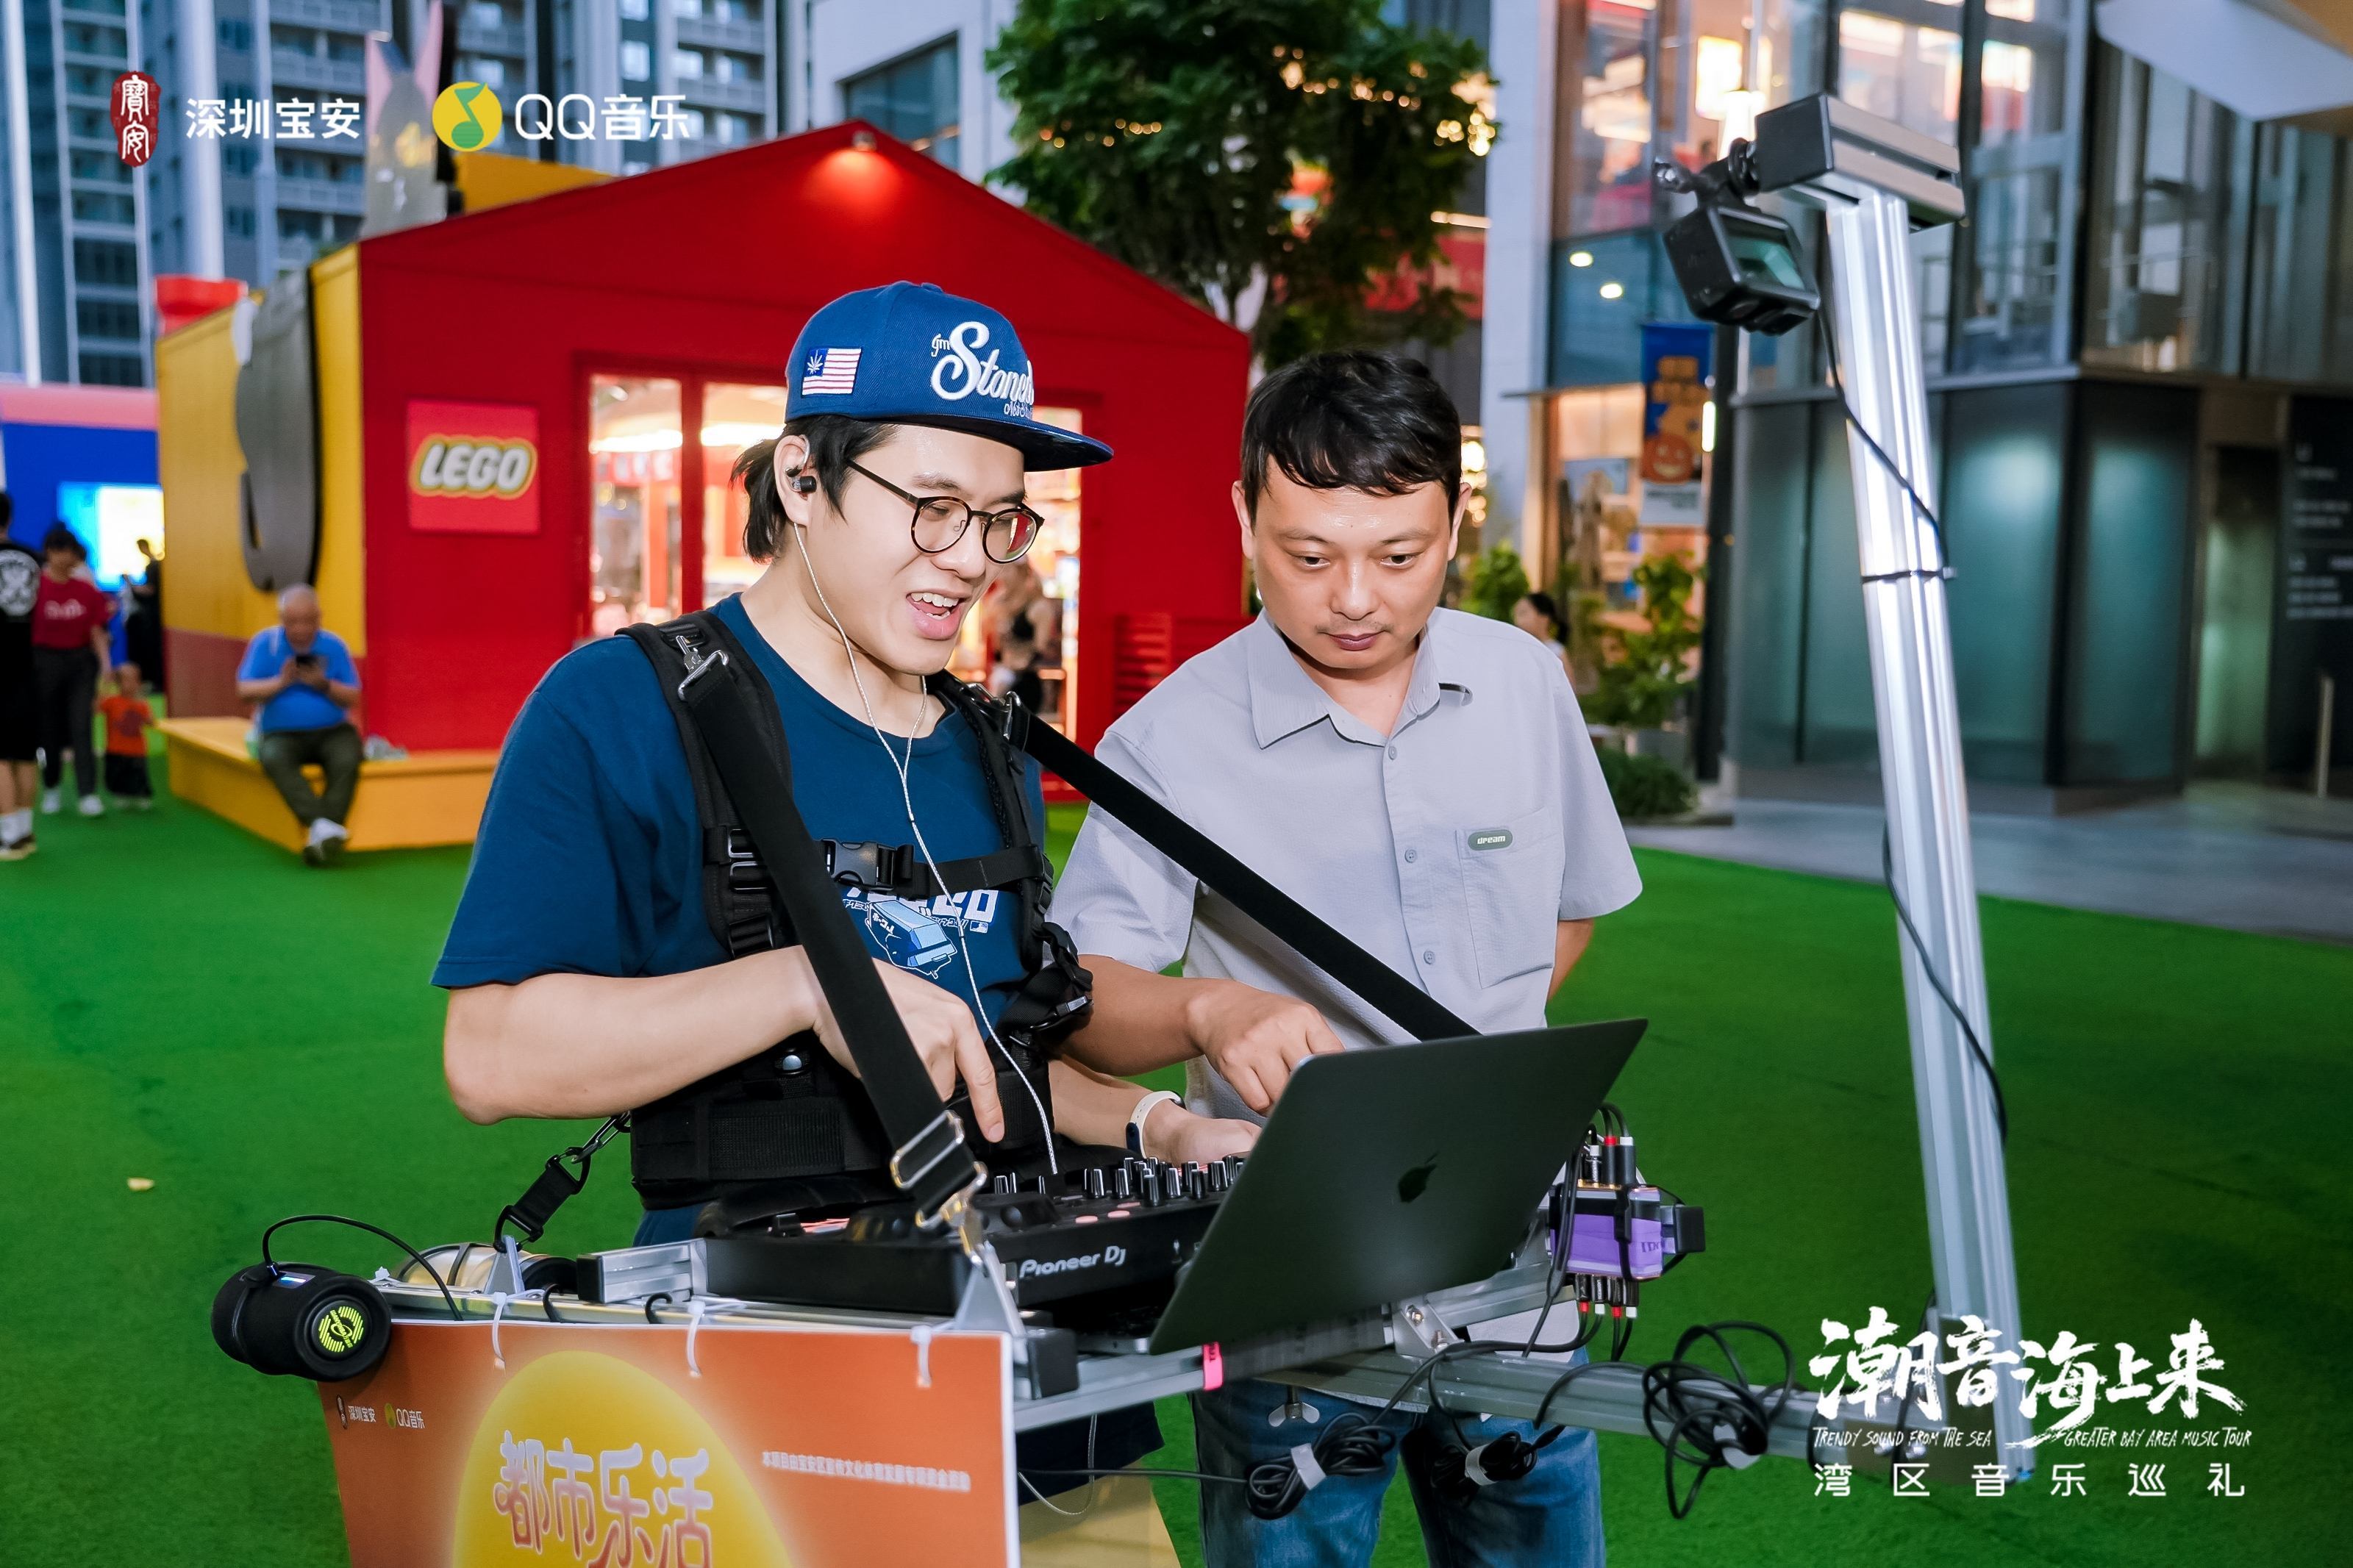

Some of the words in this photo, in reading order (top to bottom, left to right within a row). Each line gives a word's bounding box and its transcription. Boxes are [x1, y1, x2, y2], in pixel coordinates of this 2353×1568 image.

[930, 321, 1035, 406] Stoned
[419, 443, 530, 491] LEGO
[1019, 1253, 1101, 1278] Pioneer
[348, 1405, 376, 1423] 深圳宝安
[396, 1408, 426, 1430] QQ音乐
[493, 1429, 713, 1568] 都市乐活
